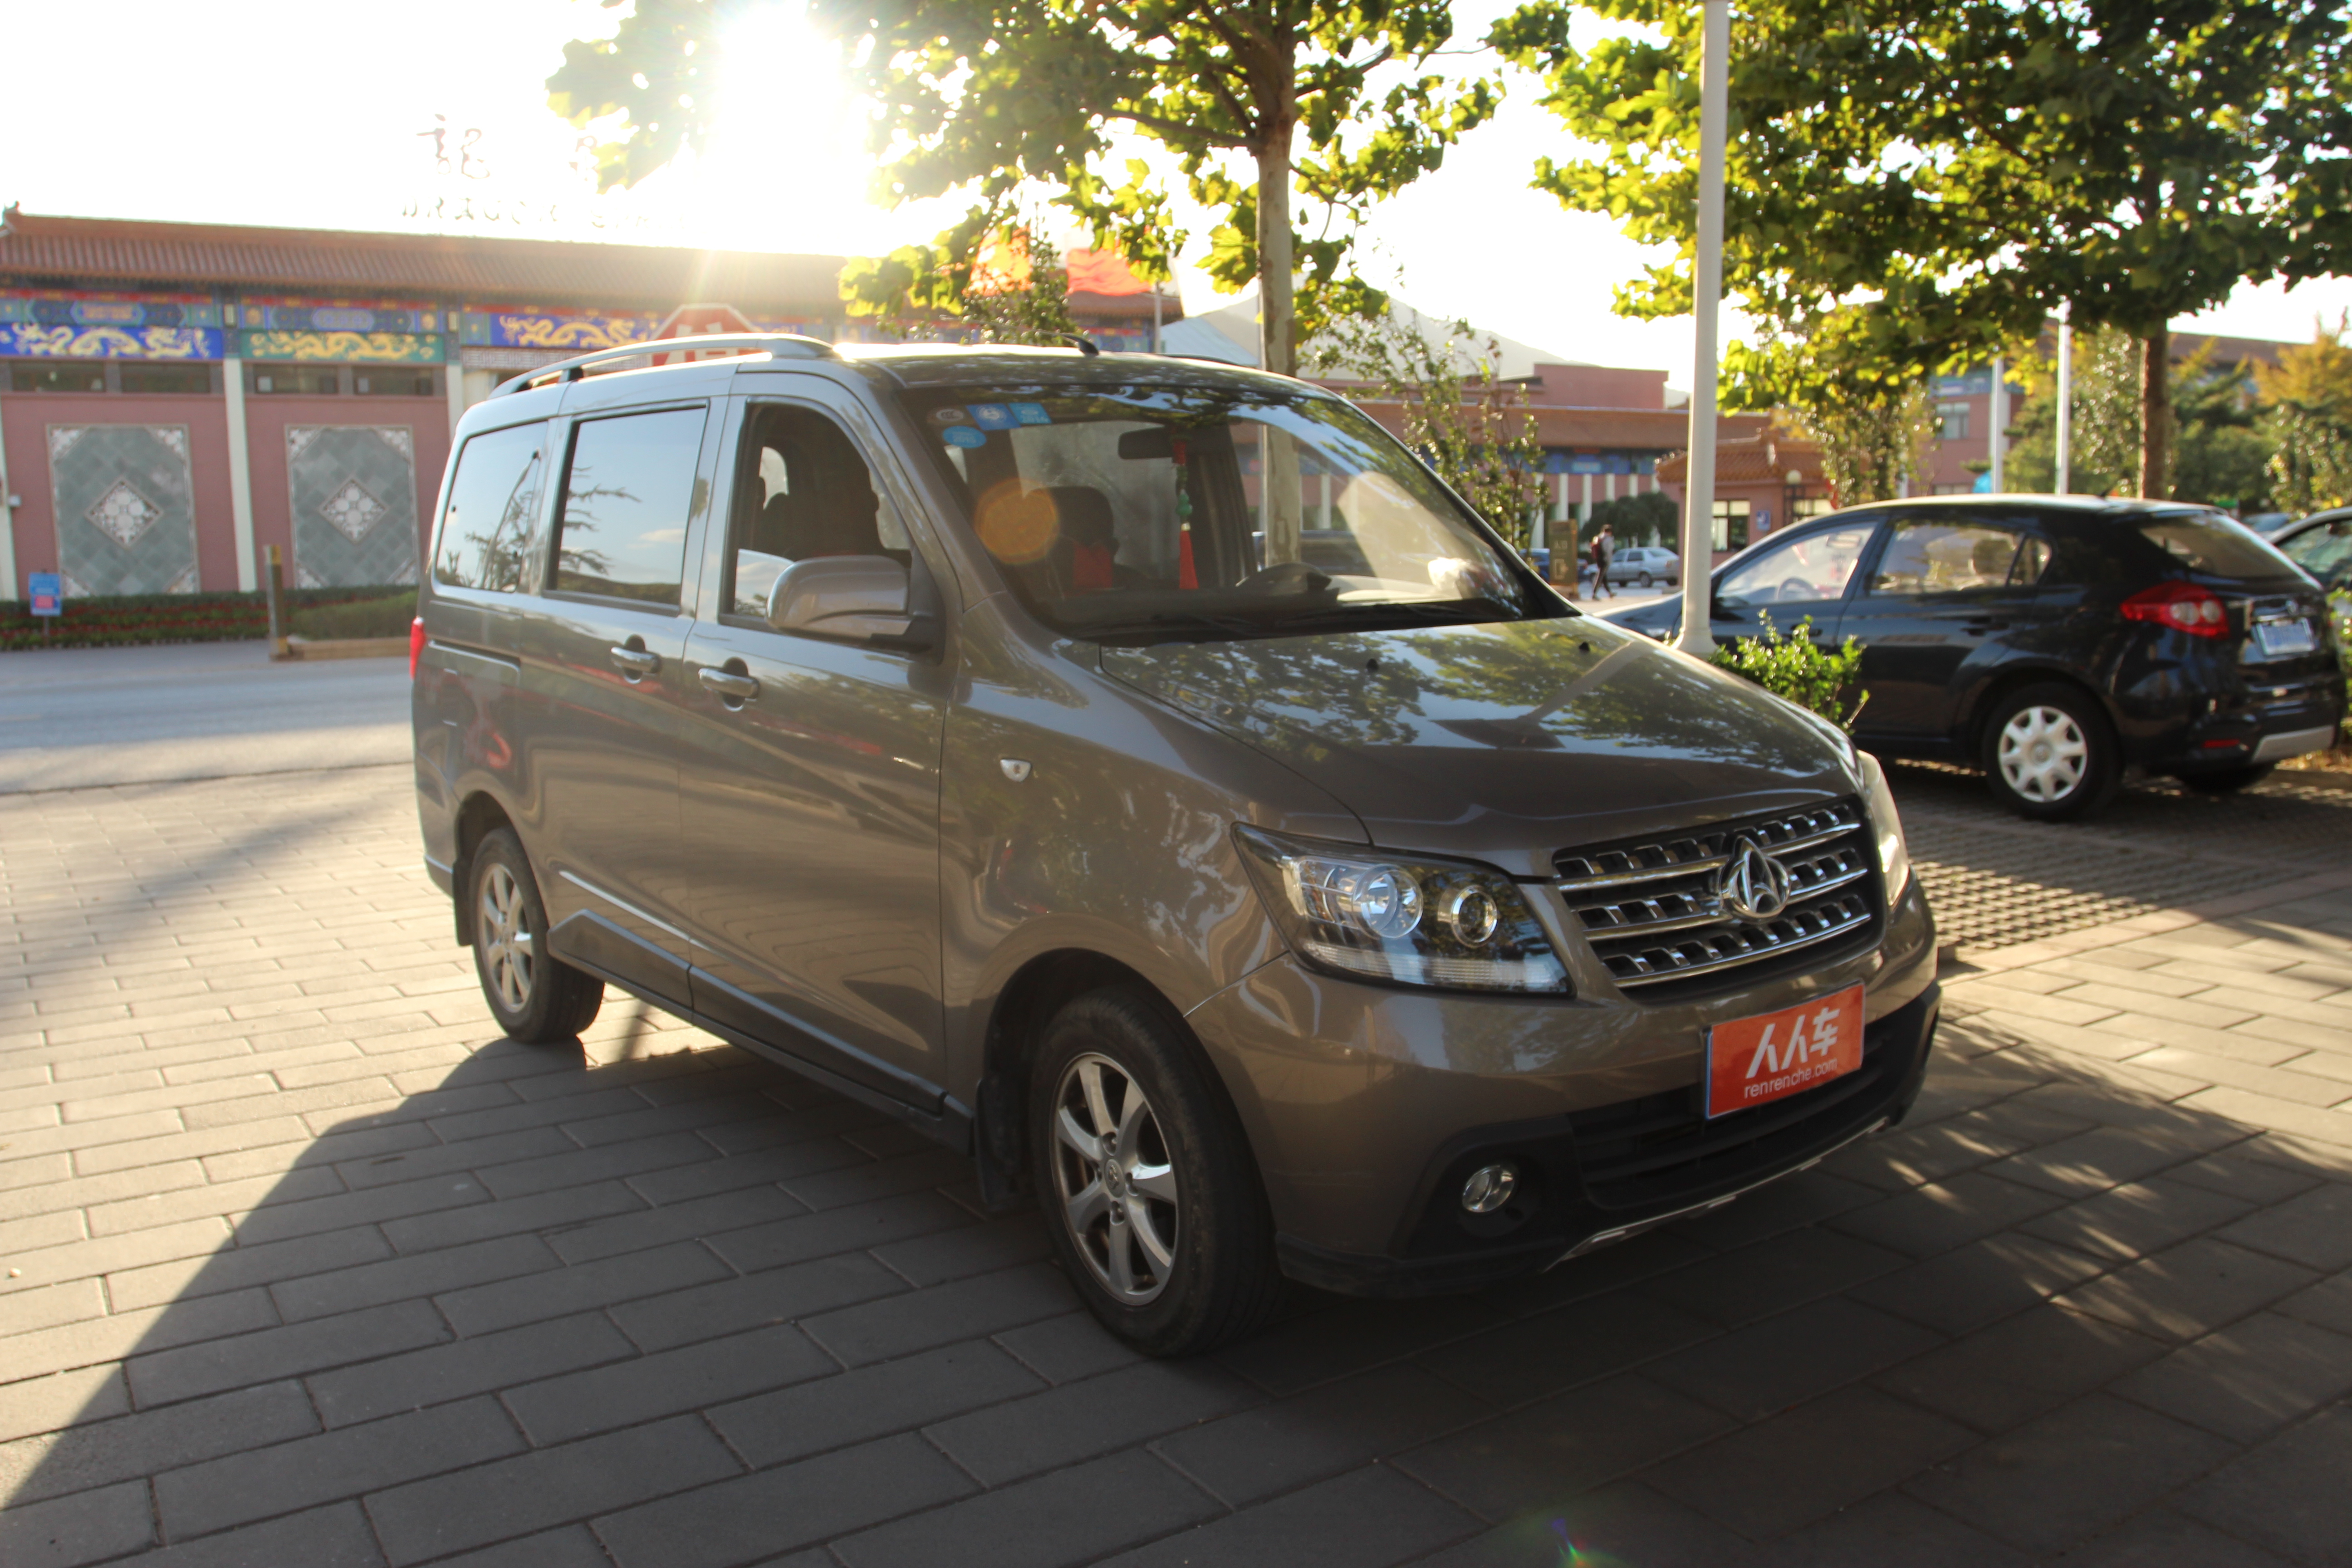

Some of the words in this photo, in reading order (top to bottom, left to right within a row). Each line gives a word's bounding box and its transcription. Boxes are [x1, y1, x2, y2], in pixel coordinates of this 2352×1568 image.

[1745, 1007, 1840, 1079] 人人车
[1744, 1058, 1838, 1098] renrenche.com
